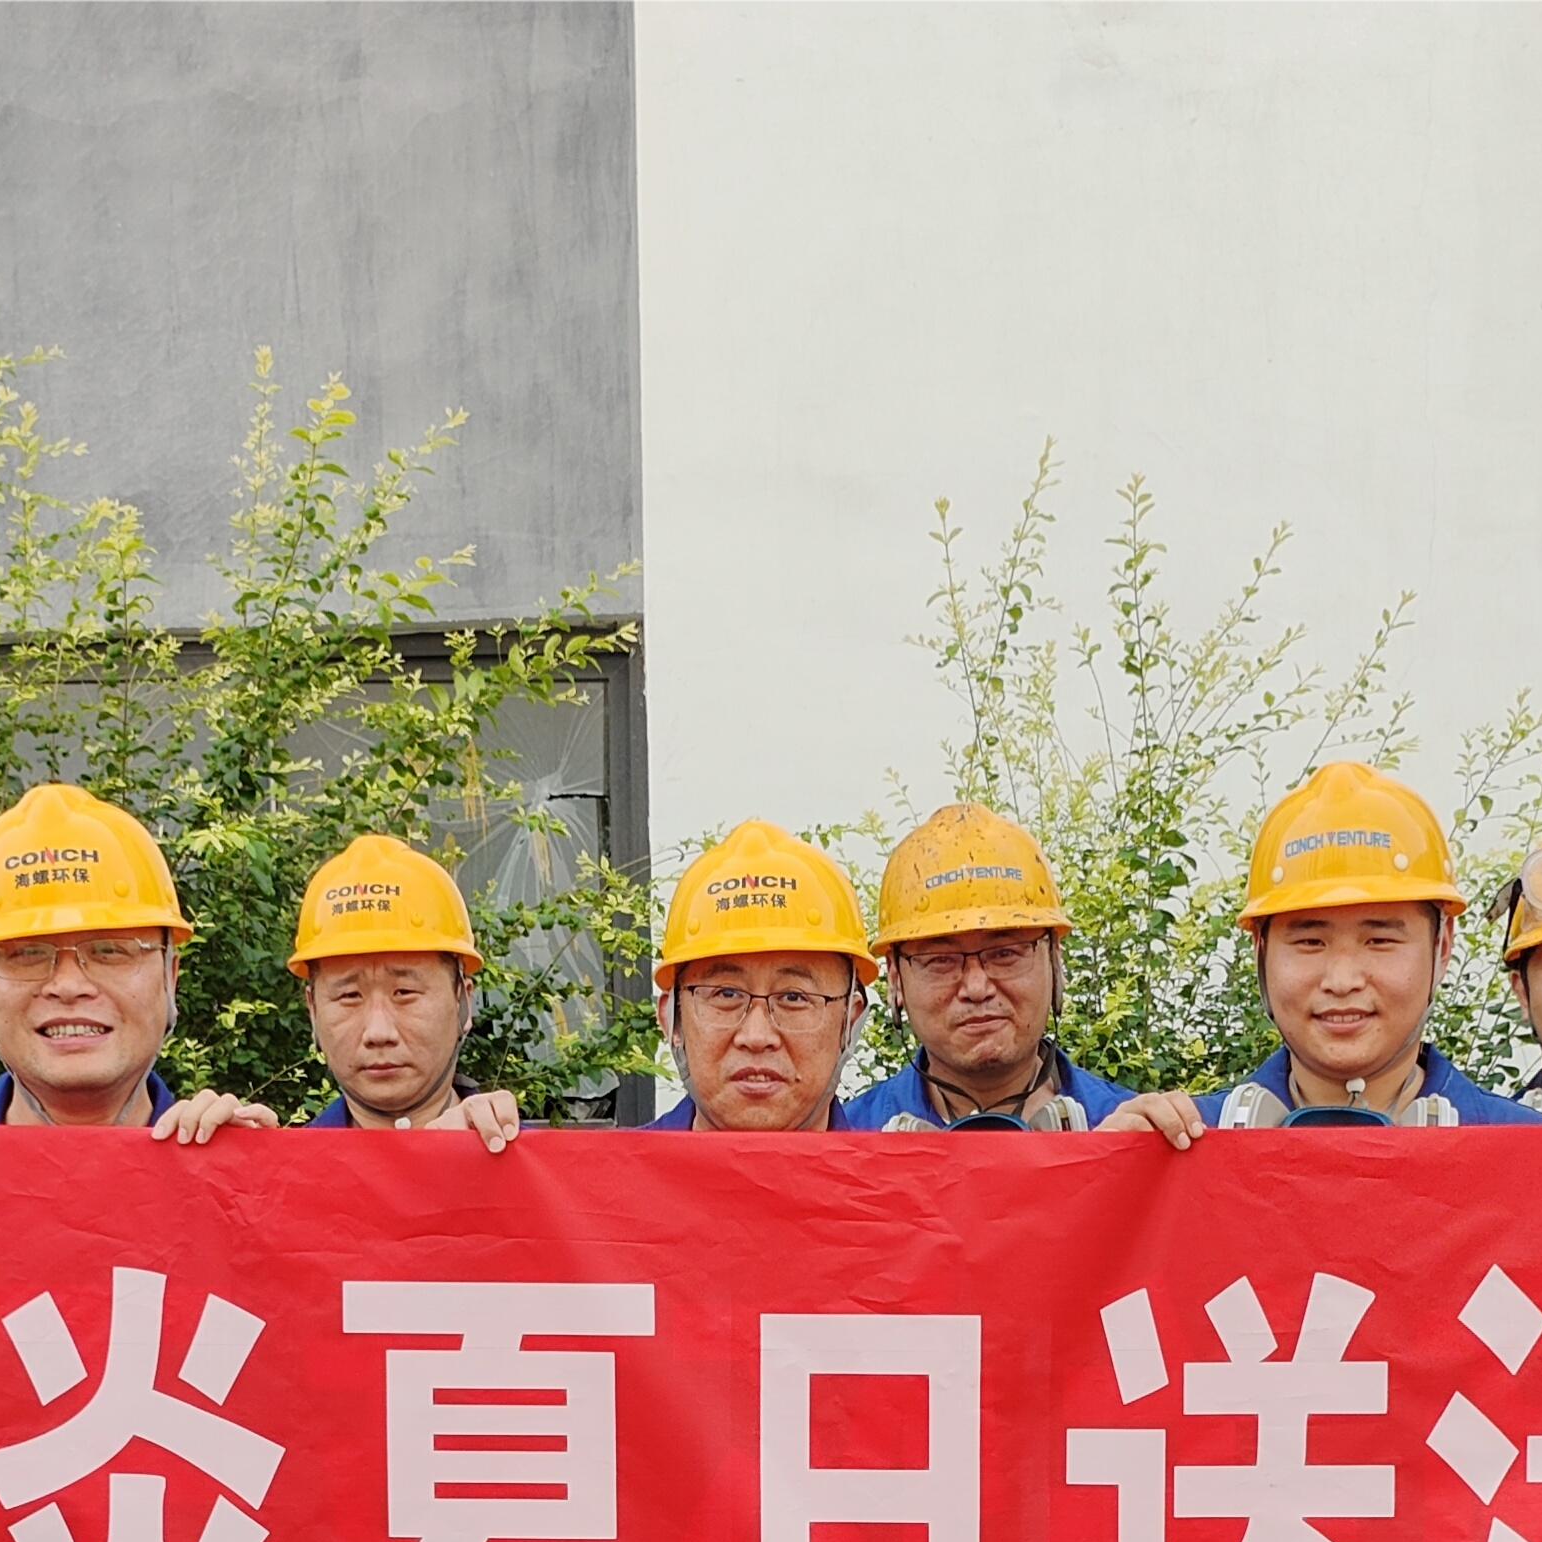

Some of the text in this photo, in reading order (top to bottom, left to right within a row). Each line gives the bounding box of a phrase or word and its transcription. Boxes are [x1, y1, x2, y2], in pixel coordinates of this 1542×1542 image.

[6, 848, 99, 869] CONCH
[15, 868, 90, 888] 海螺环保
[708, 874, 796, 895] CONCH
[327, 883, 400, 900] CONCH
[716, 894, 786, 912] 海螺环保
